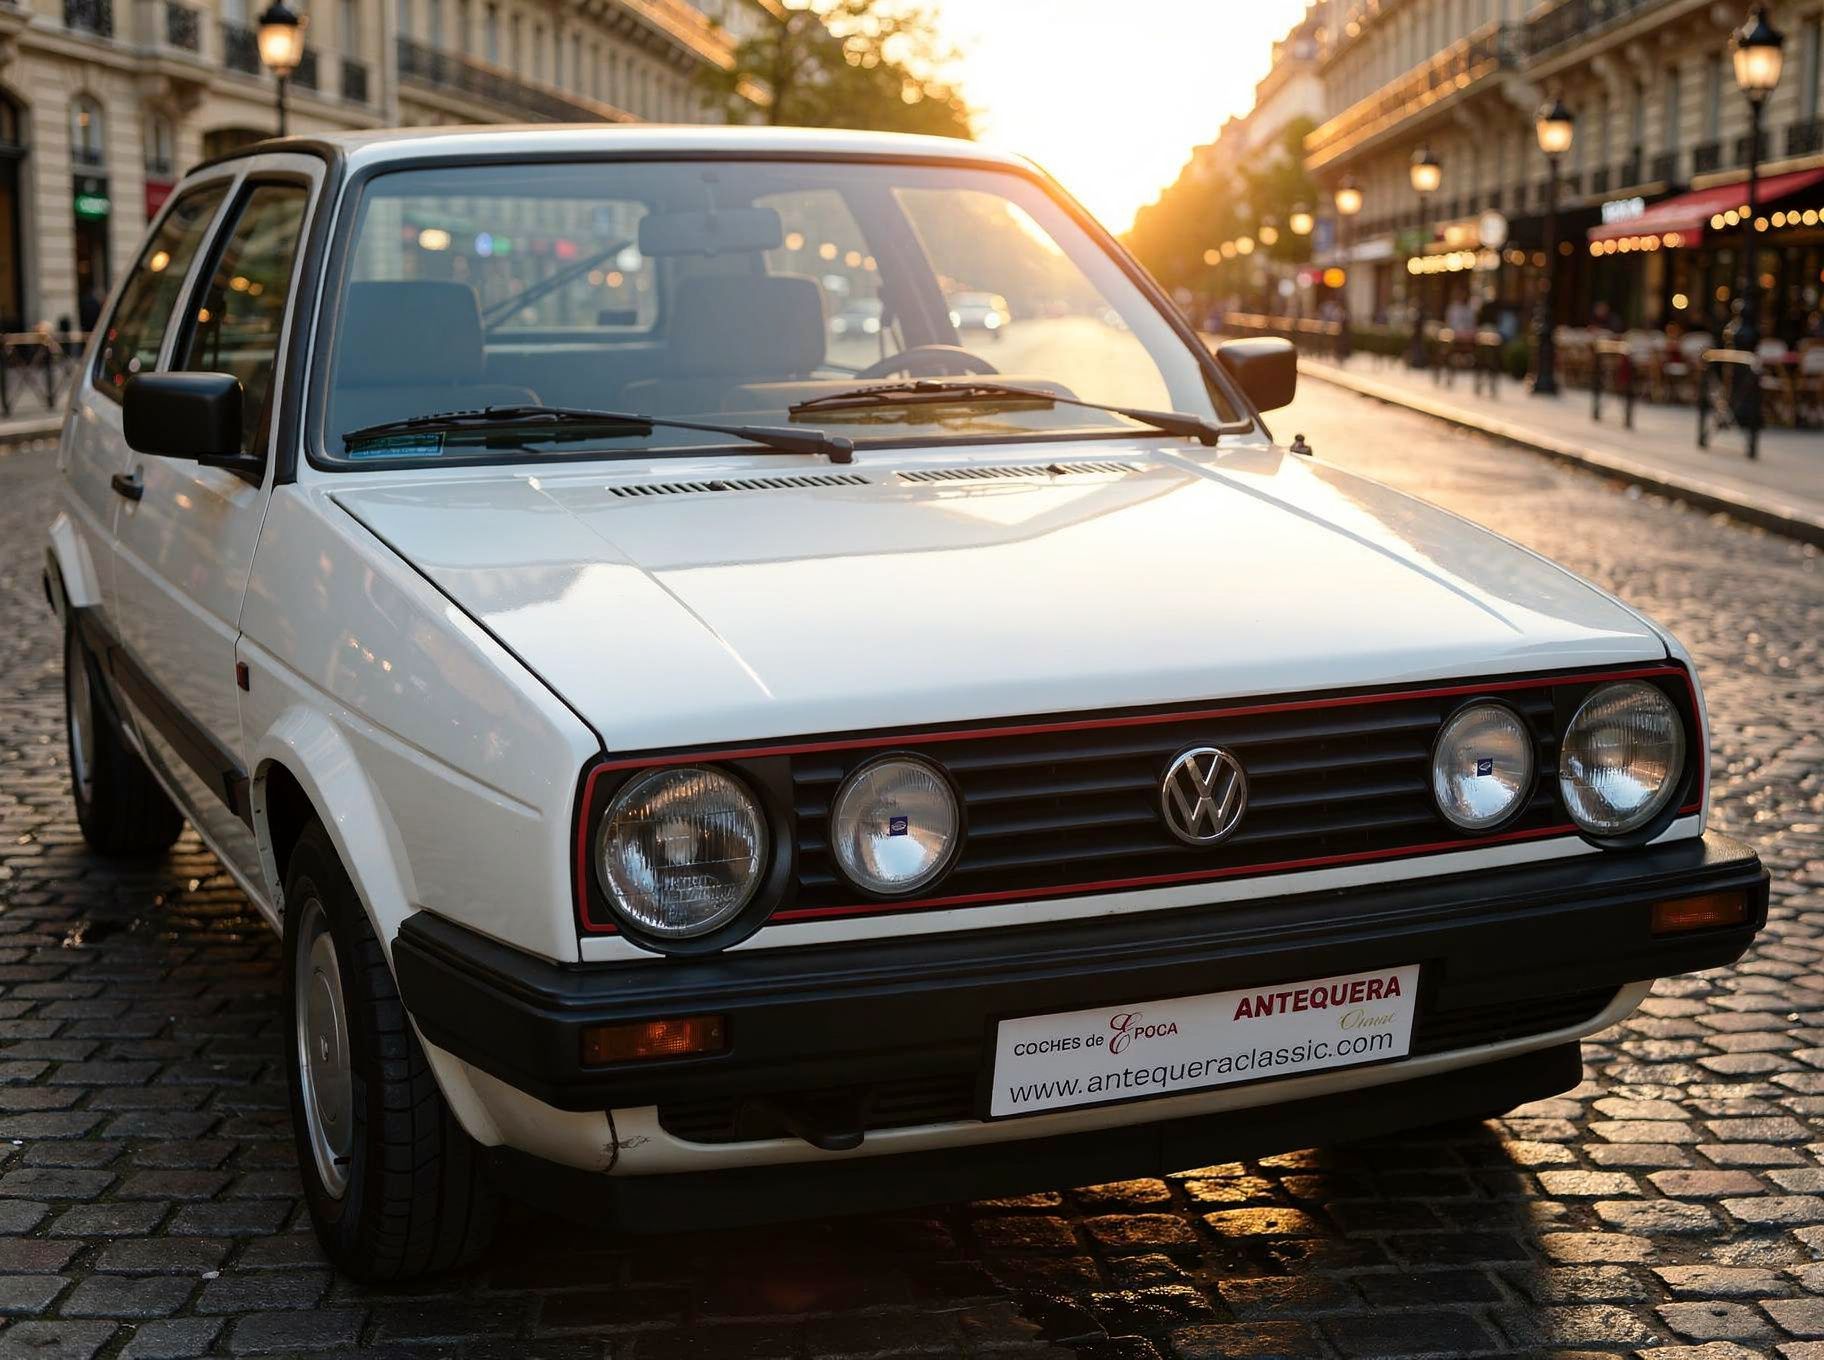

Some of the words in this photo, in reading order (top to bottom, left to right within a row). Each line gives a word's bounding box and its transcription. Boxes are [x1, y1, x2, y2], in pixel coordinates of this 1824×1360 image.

[1163, 749, 1246, 843] VW
[1233, 975, 1401, 1021] ANTEQUERA
[1010, 1032, 1393, 1103] www.antequeraclassic.com
[1013, 1037, 1081, 1056] COCHES
[1085, 1033, 1104, 1048] de
